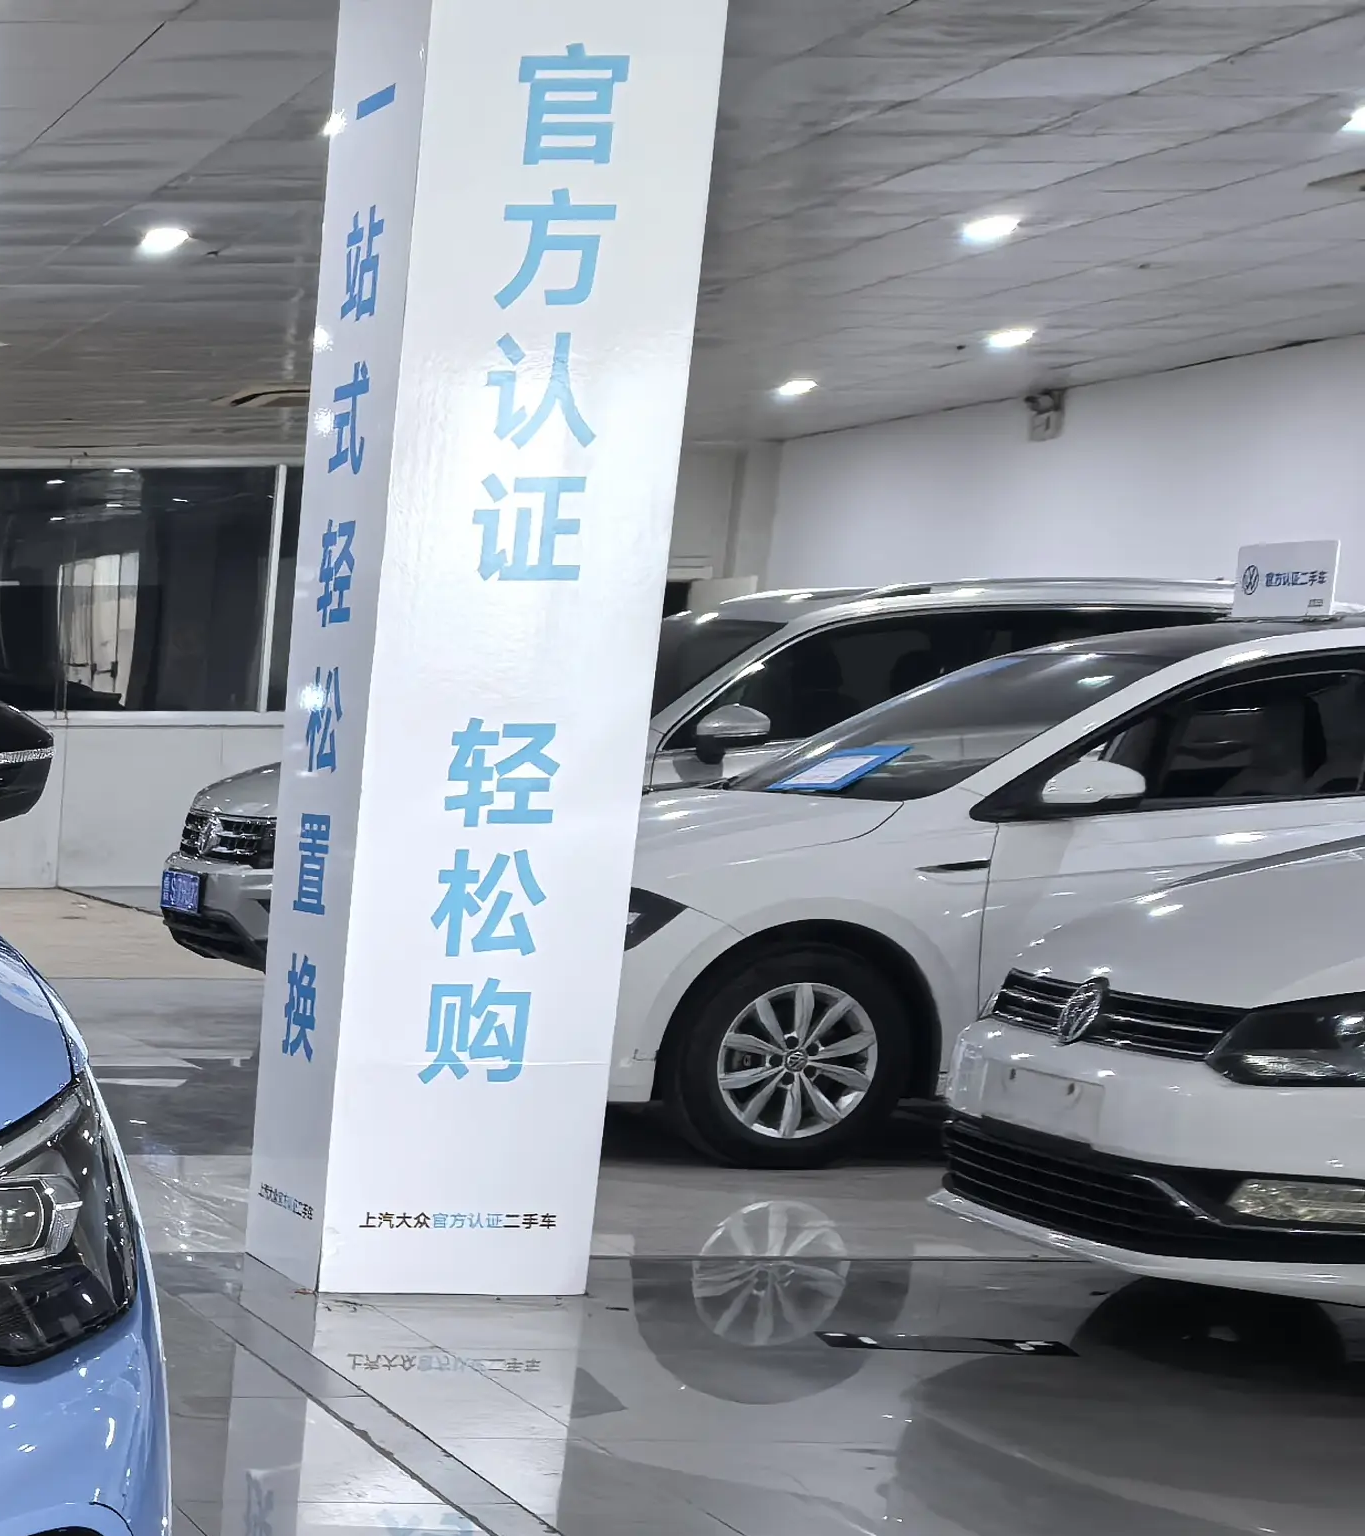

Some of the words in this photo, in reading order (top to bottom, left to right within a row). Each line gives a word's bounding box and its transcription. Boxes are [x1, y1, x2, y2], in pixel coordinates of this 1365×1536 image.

[473, 43, 630, 582] 官方认证
[417, 717, 561, 1085] 轻松购
[359, 1212, 557, 1230] 上汽大众官方认证二手车
